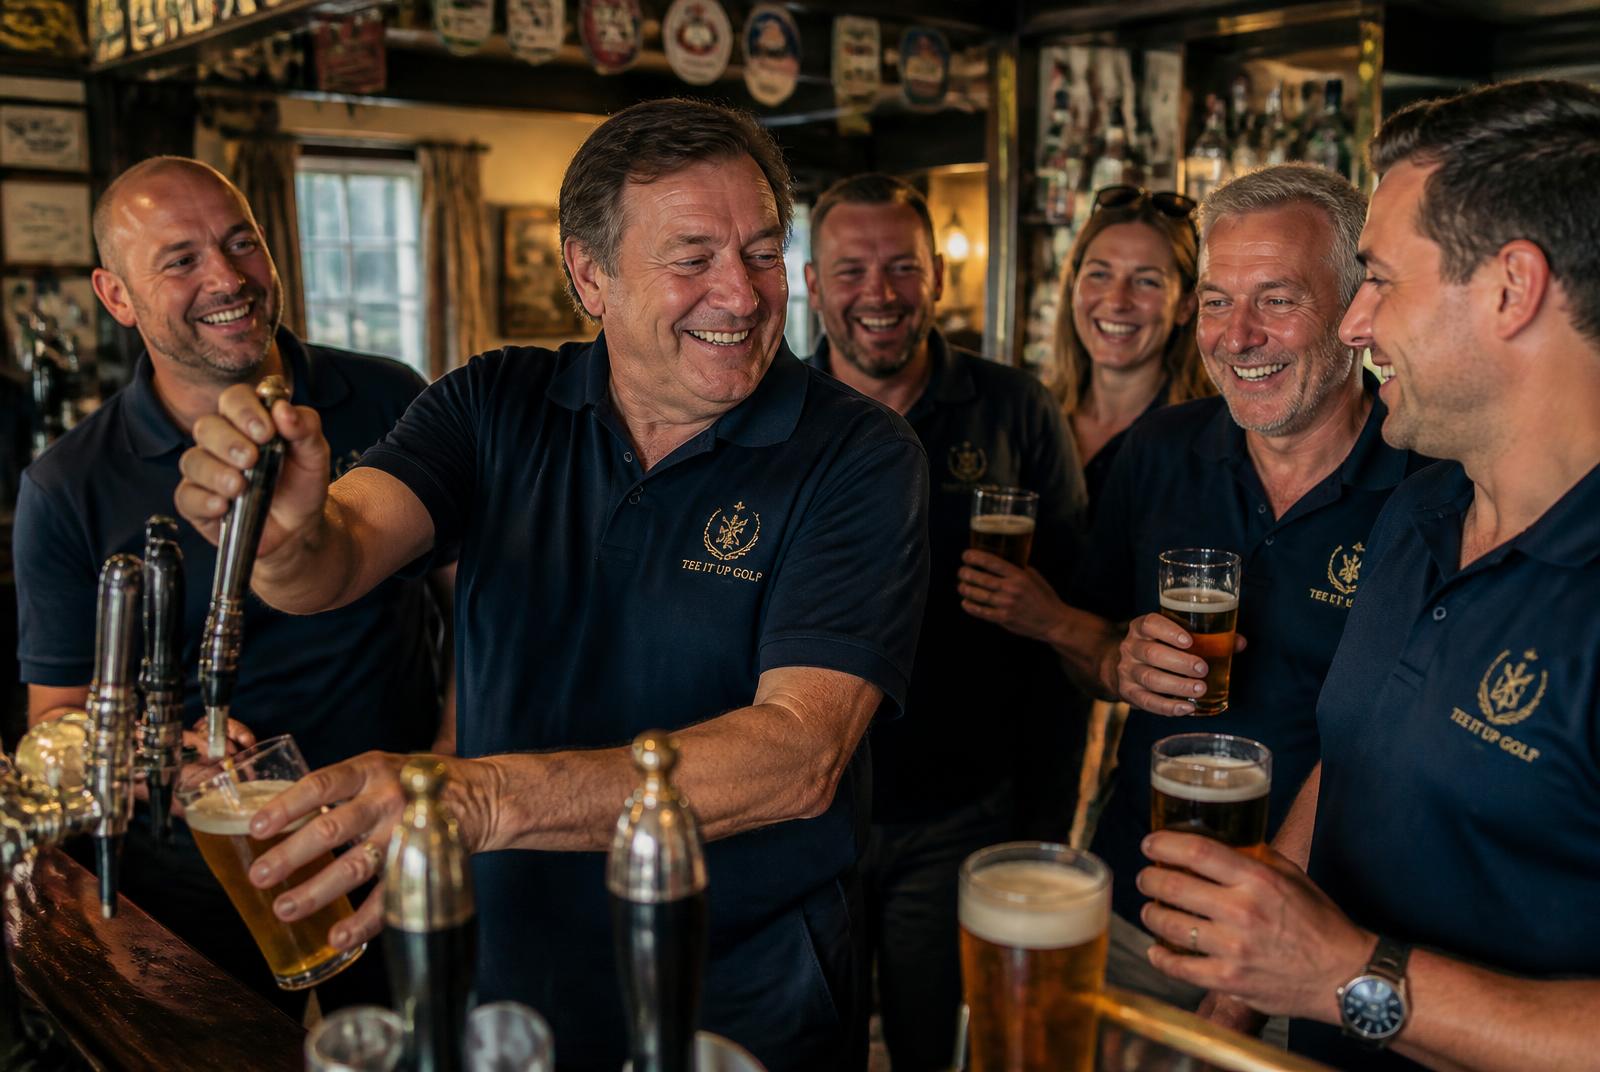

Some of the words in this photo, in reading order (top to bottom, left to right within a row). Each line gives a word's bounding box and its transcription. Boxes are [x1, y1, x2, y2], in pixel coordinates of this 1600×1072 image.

[682, 559, 702, 571] TEE
[702, 562, 715, 573] IT
[716, 564, 731, 576] UP
[1309, 588, 1329, 601] TEE
[1345, 598, 1354, 608] U
[1450, 706, 1473, 728] TEE
[1481, 725, 1501, 743] UP
